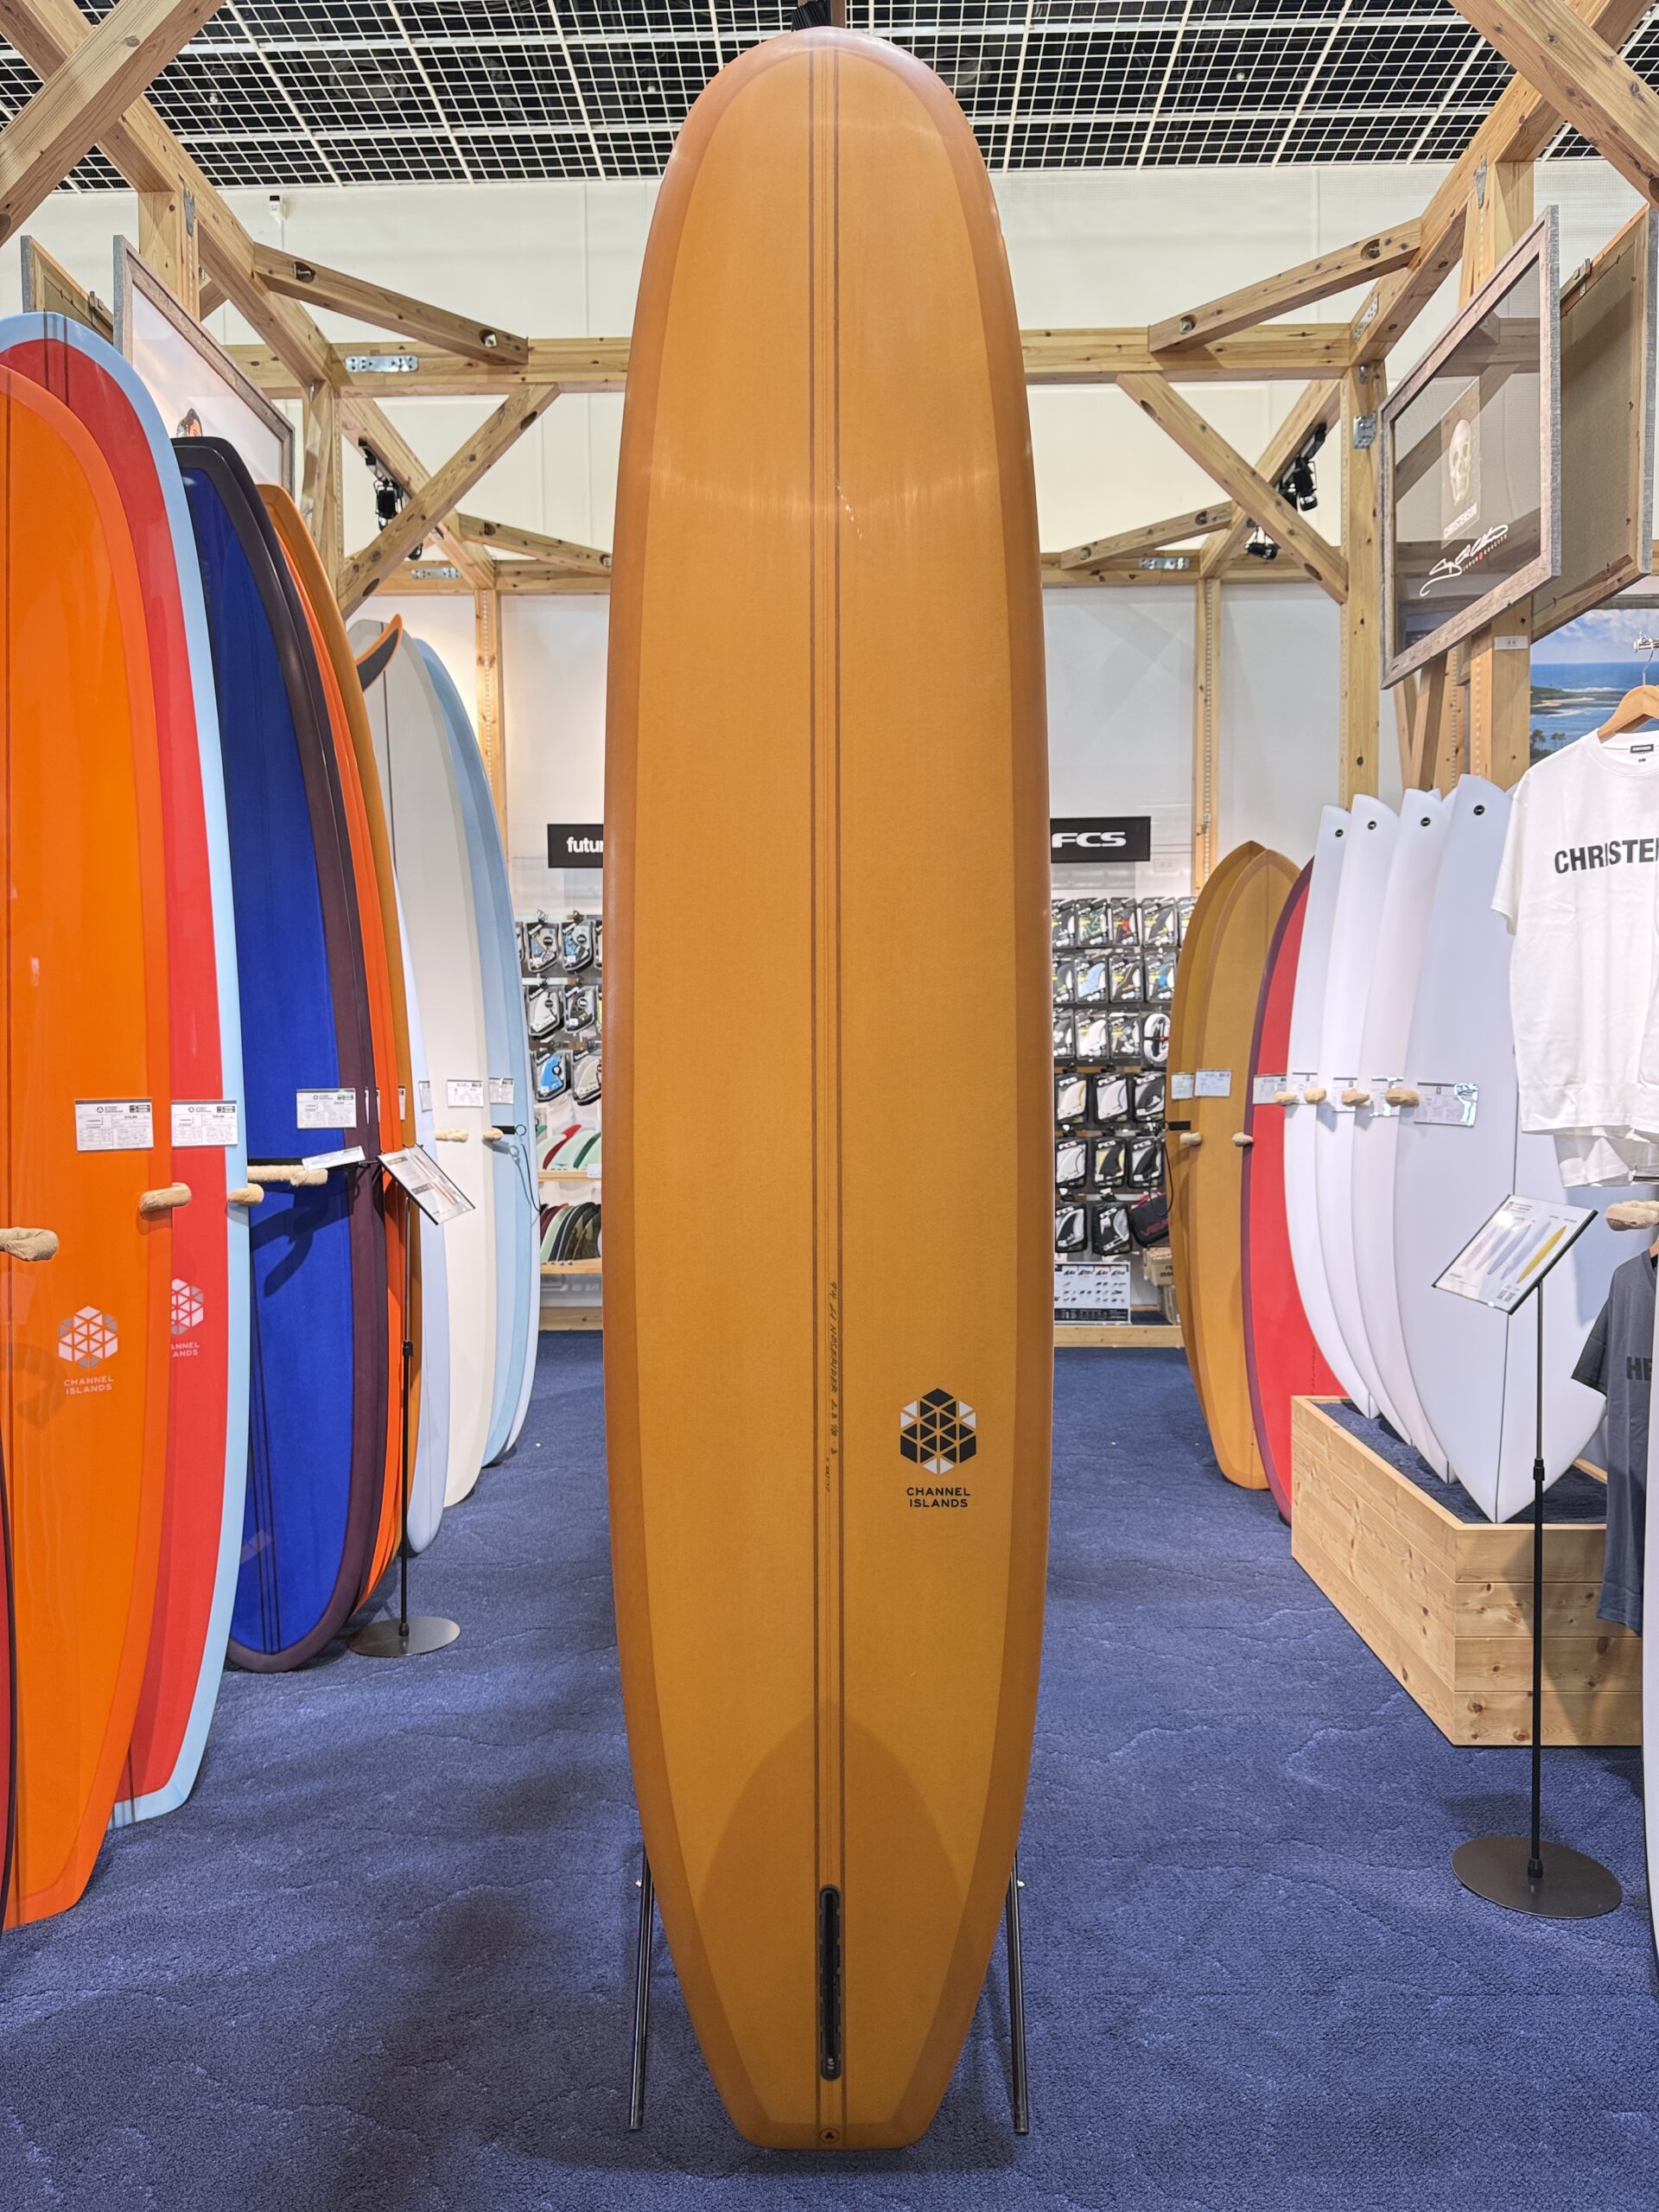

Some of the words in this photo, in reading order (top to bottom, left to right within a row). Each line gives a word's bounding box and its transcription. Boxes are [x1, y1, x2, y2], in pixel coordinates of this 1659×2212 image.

[1052, 831, 1127, 849] FCS
[1554, 837, 1659, 874] CHRISTE
[64, 1376, 114, 1387] CHANNEL
[66, 1384, 112, 1395] ISLANDS
[906, 1487, 971, 1497] CHANNEL
[909, 1498, 968, 1507] ISLANDS
